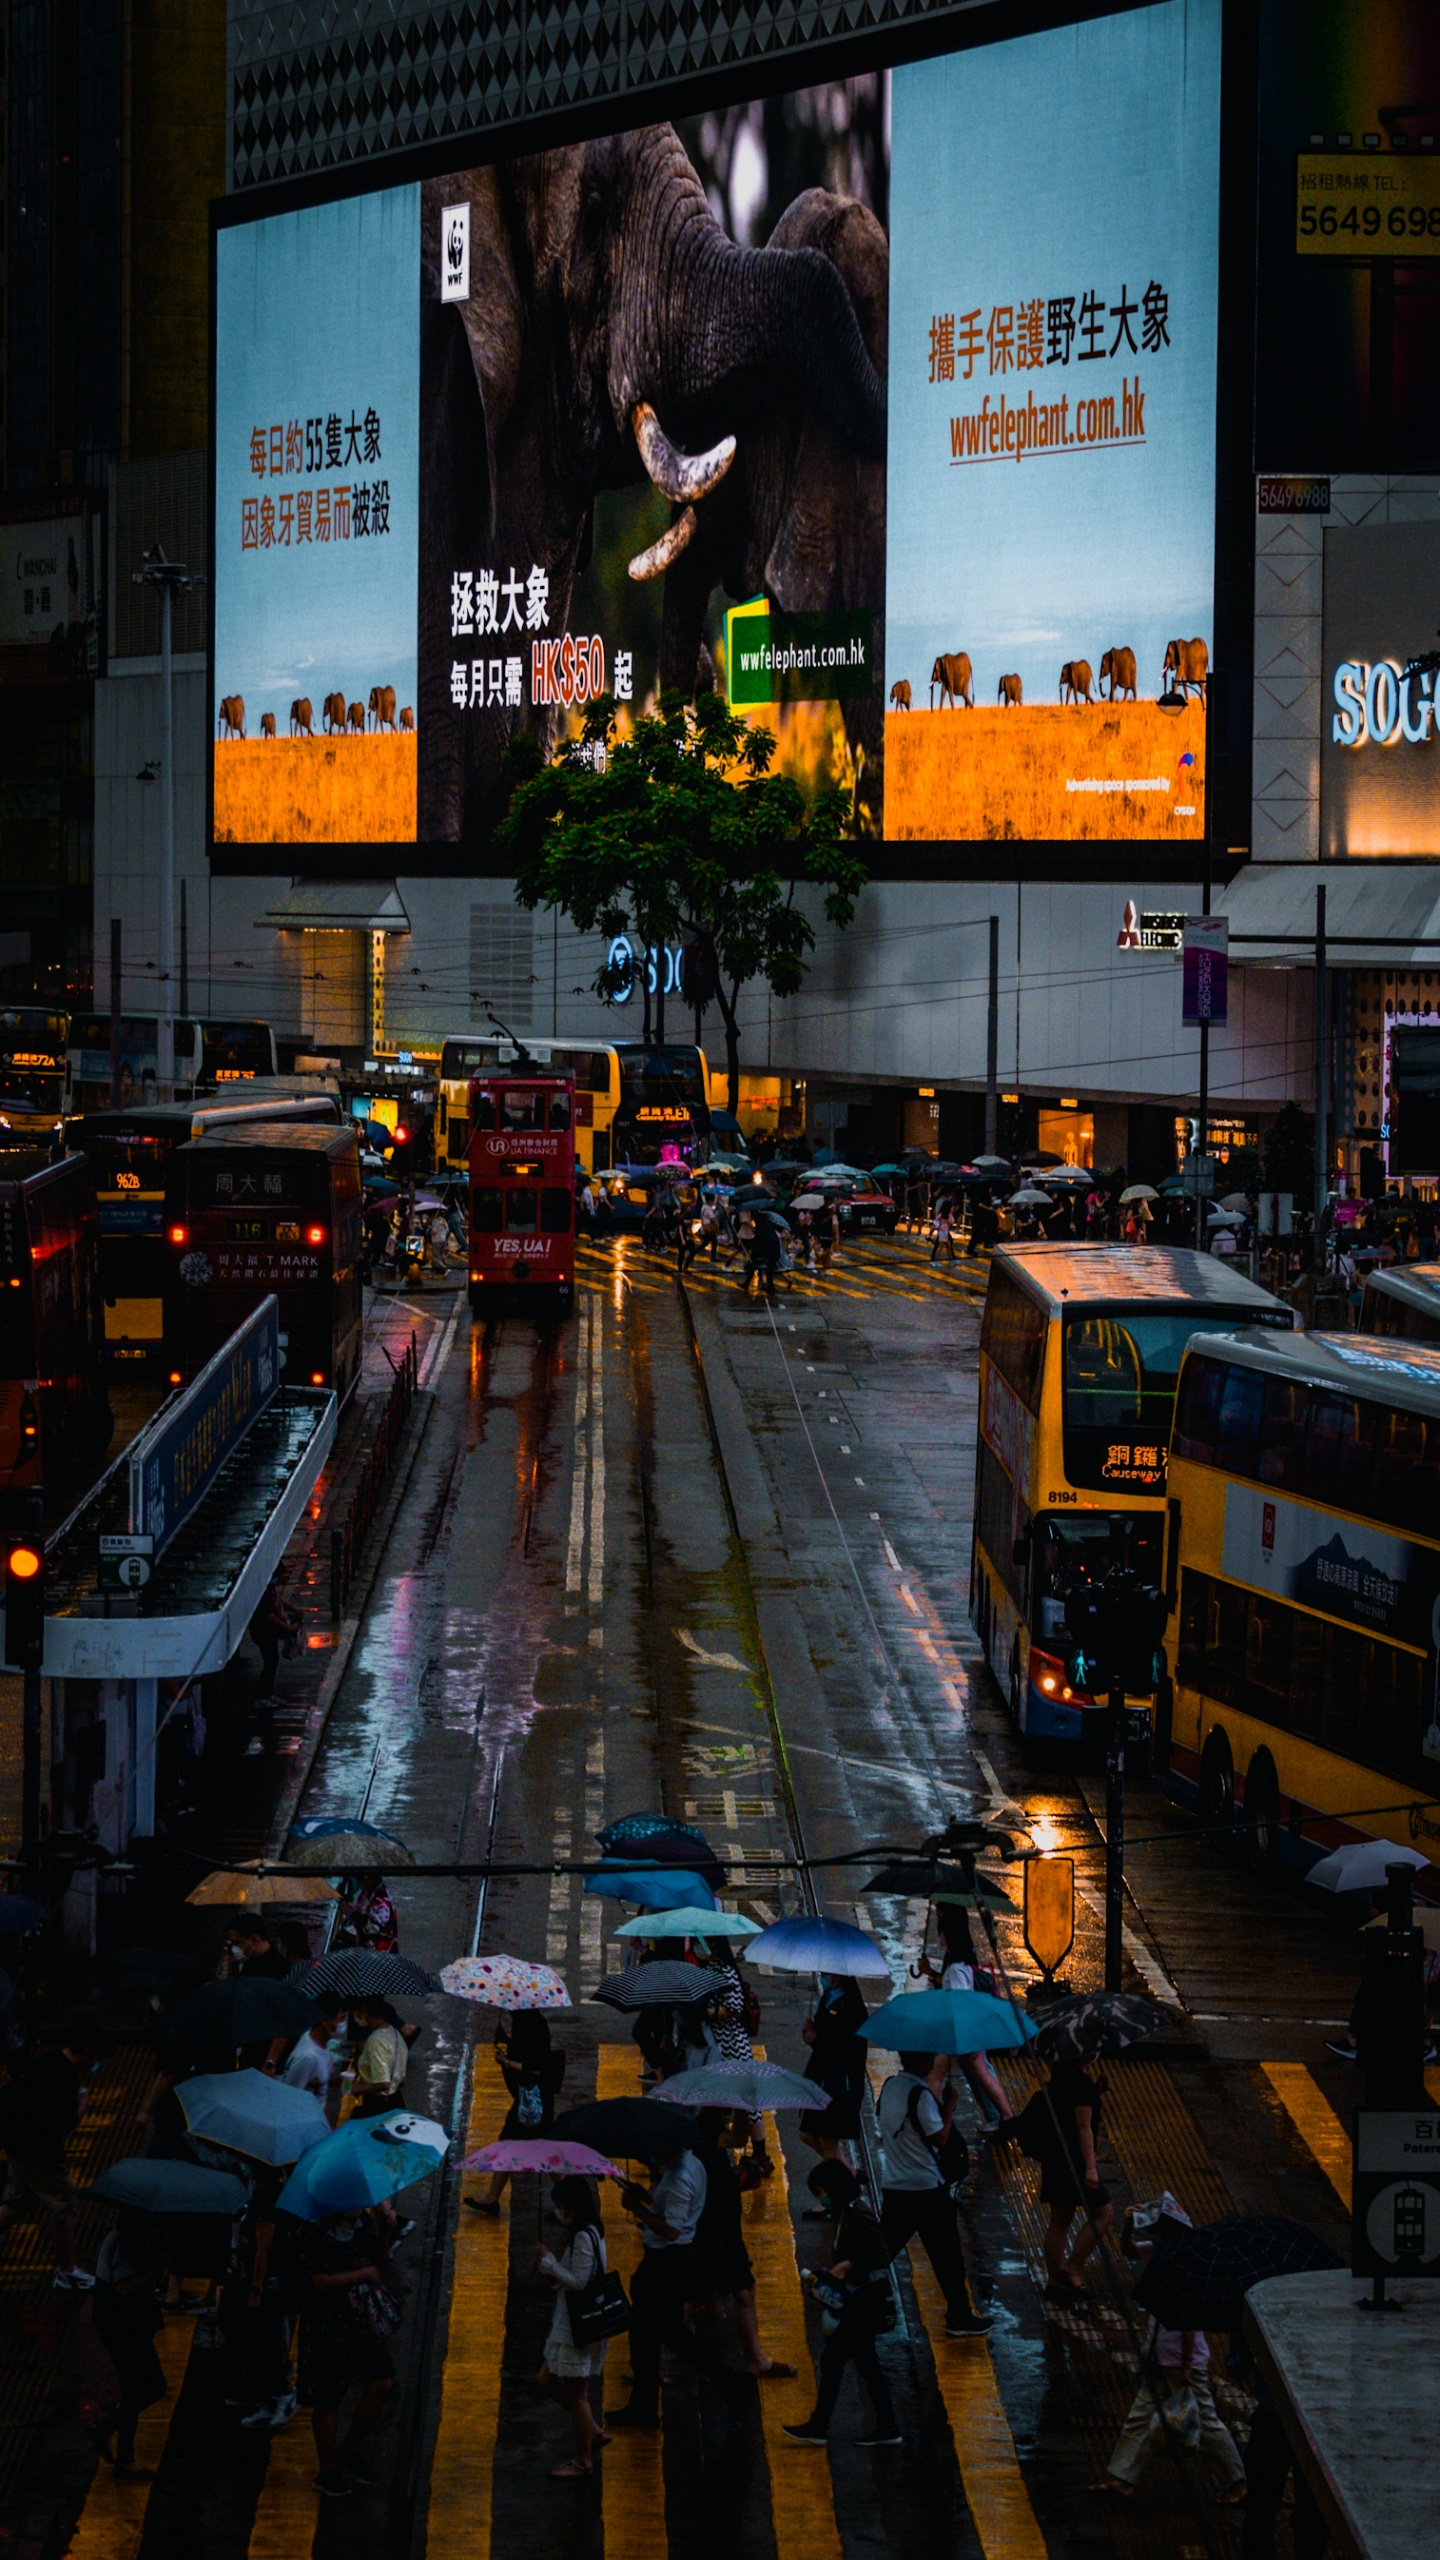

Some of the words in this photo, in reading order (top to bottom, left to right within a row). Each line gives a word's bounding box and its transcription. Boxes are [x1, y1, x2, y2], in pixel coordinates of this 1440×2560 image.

[1301, 173, 1369, 191] 招租熱線
[1300, 205, 1380, 236] 5649
[447, 272, 464, 287] WWF
[928, 279, 1171, 384] 攜手保護野生大象
[950, 376, 1146, 463] wwfelephant.com.hk
[250, 406, 381, 480] 每日約55隻大象
[1260, 485, 1293, 507] 5649
[1295, 485, 1329, 507] 6988
[242, 480, 390, 552] 因象牙貿易而被殺
[451, 563, 550, 638] 拯救大象
[741, 637, 866, 675] wwfelephant.com.hk
[450, 657, 523, 711] 每月只需
[531, 632, 605, 709] HK$50
[614, 650, 633, 701] 起
[1332, 662, 1440, 746] SOG
[525, 1147, 558, 1155] FINANCE
[117, 1172, 140, 1189] 962B
[216, 1173, 284, 1194] 周大福
[235, 1223, 262, 1240] 116
[219, 1254, 259, 1267] 周大福
[267, 1255, 273, 1266] T
[281, 1256, 319, 1266] MARK
[1101, 1464, 1162, 1480] Causeway
[1048, 1491, 1078, 1503] 8194
